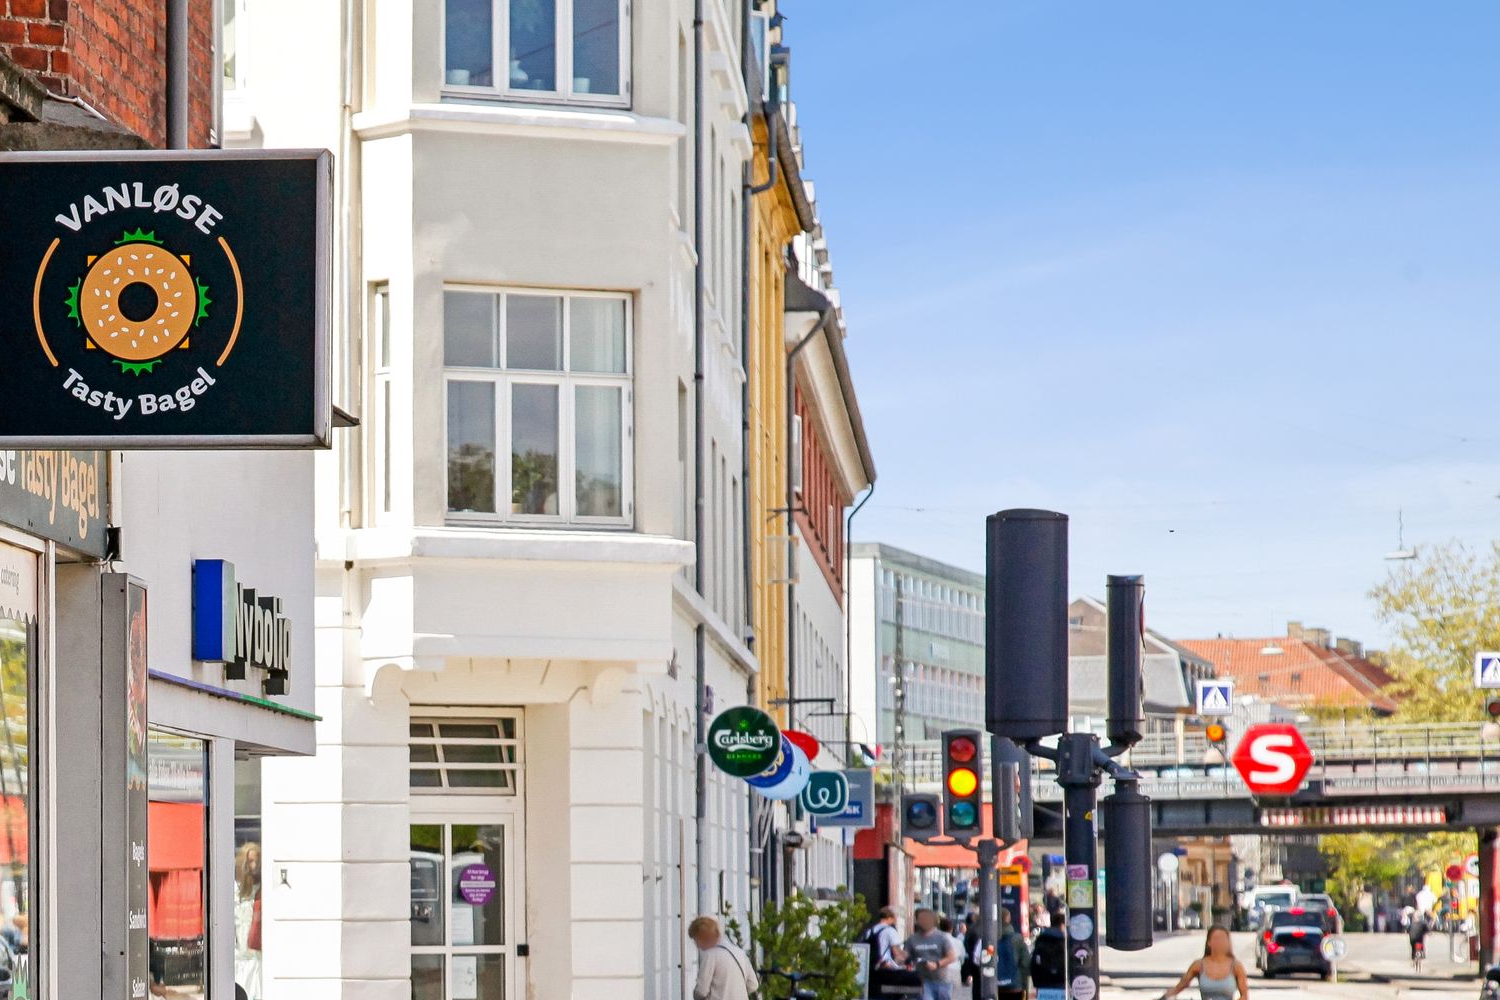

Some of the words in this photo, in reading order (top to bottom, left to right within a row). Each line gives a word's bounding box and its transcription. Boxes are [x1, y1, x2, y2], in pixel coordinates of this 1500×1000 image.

[55, 182, 223, 234] VANLØSE
[62, 368, 133, 420] Tasty
[138, 366, 216, 415] Bagel
[62, 450, 99, 539] Bagel
[235, 580, 291, 696] Nybolig
[714, 729, 773, 752] Carlsberg
[1250, 734, 1296, 785] S
